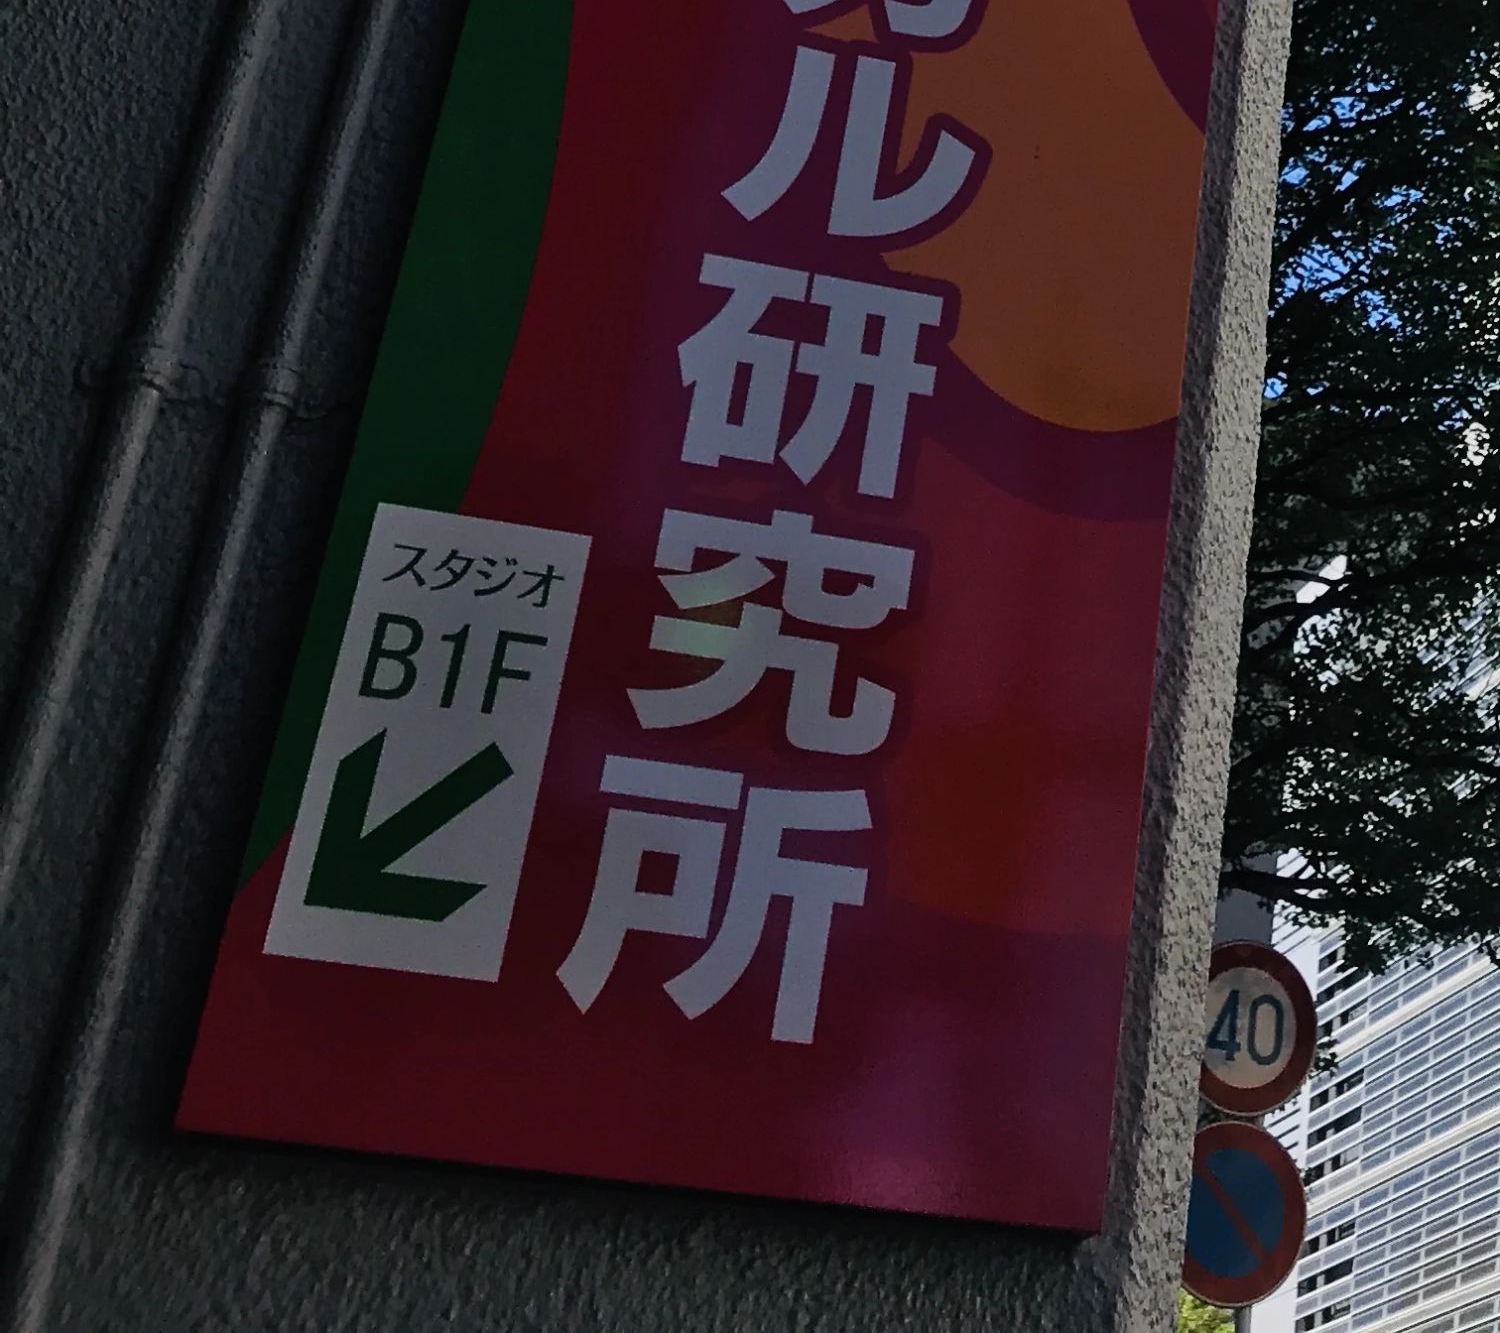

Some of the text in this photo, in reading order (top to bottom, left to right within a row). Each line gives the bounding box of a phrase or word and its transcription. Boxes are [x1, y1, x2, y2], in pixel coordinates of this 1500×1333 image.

[382, 543, 566, 608] スタジオ
[358, 613, 548, 715] B1F
[1207, 989, 1285, 1066] 40
